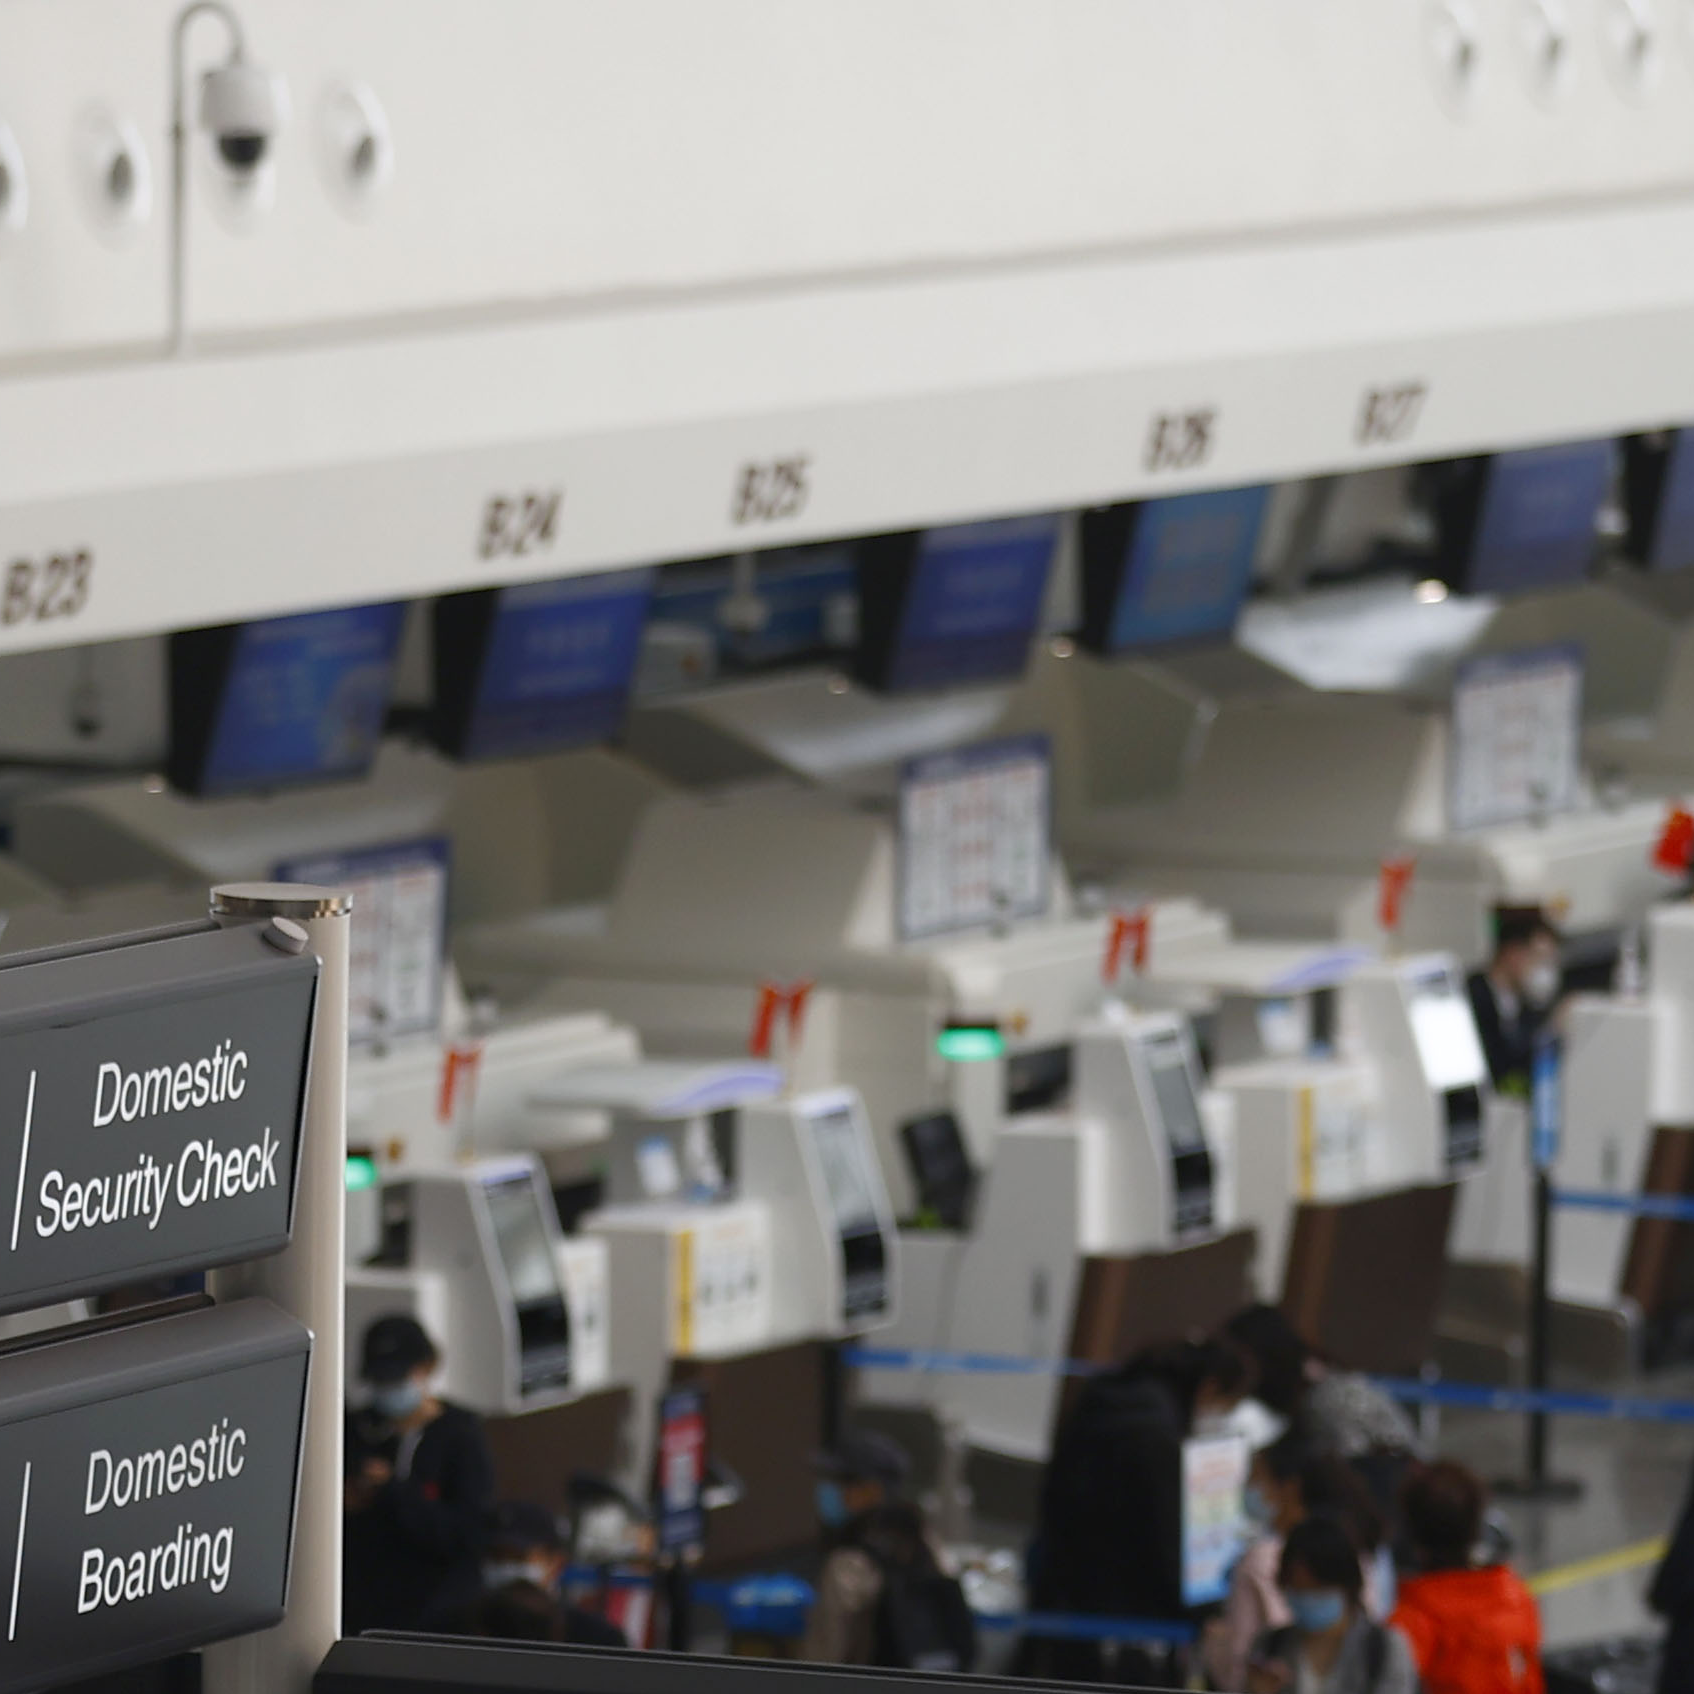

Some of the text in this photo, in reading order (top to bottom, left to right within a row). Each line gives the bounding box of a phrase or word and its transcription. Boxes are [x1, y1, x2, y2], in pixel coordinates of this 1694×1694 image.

[475, 490, 563, 562] B24
[731, 455, 810, 527] B25
[92, 1038, 249, 1129] Domestic
[35, 1126, 280, 1238] Security Check
[83, 1416, 247, 1516] Domestic
[76, 1521, 235, 1614] Boarding
